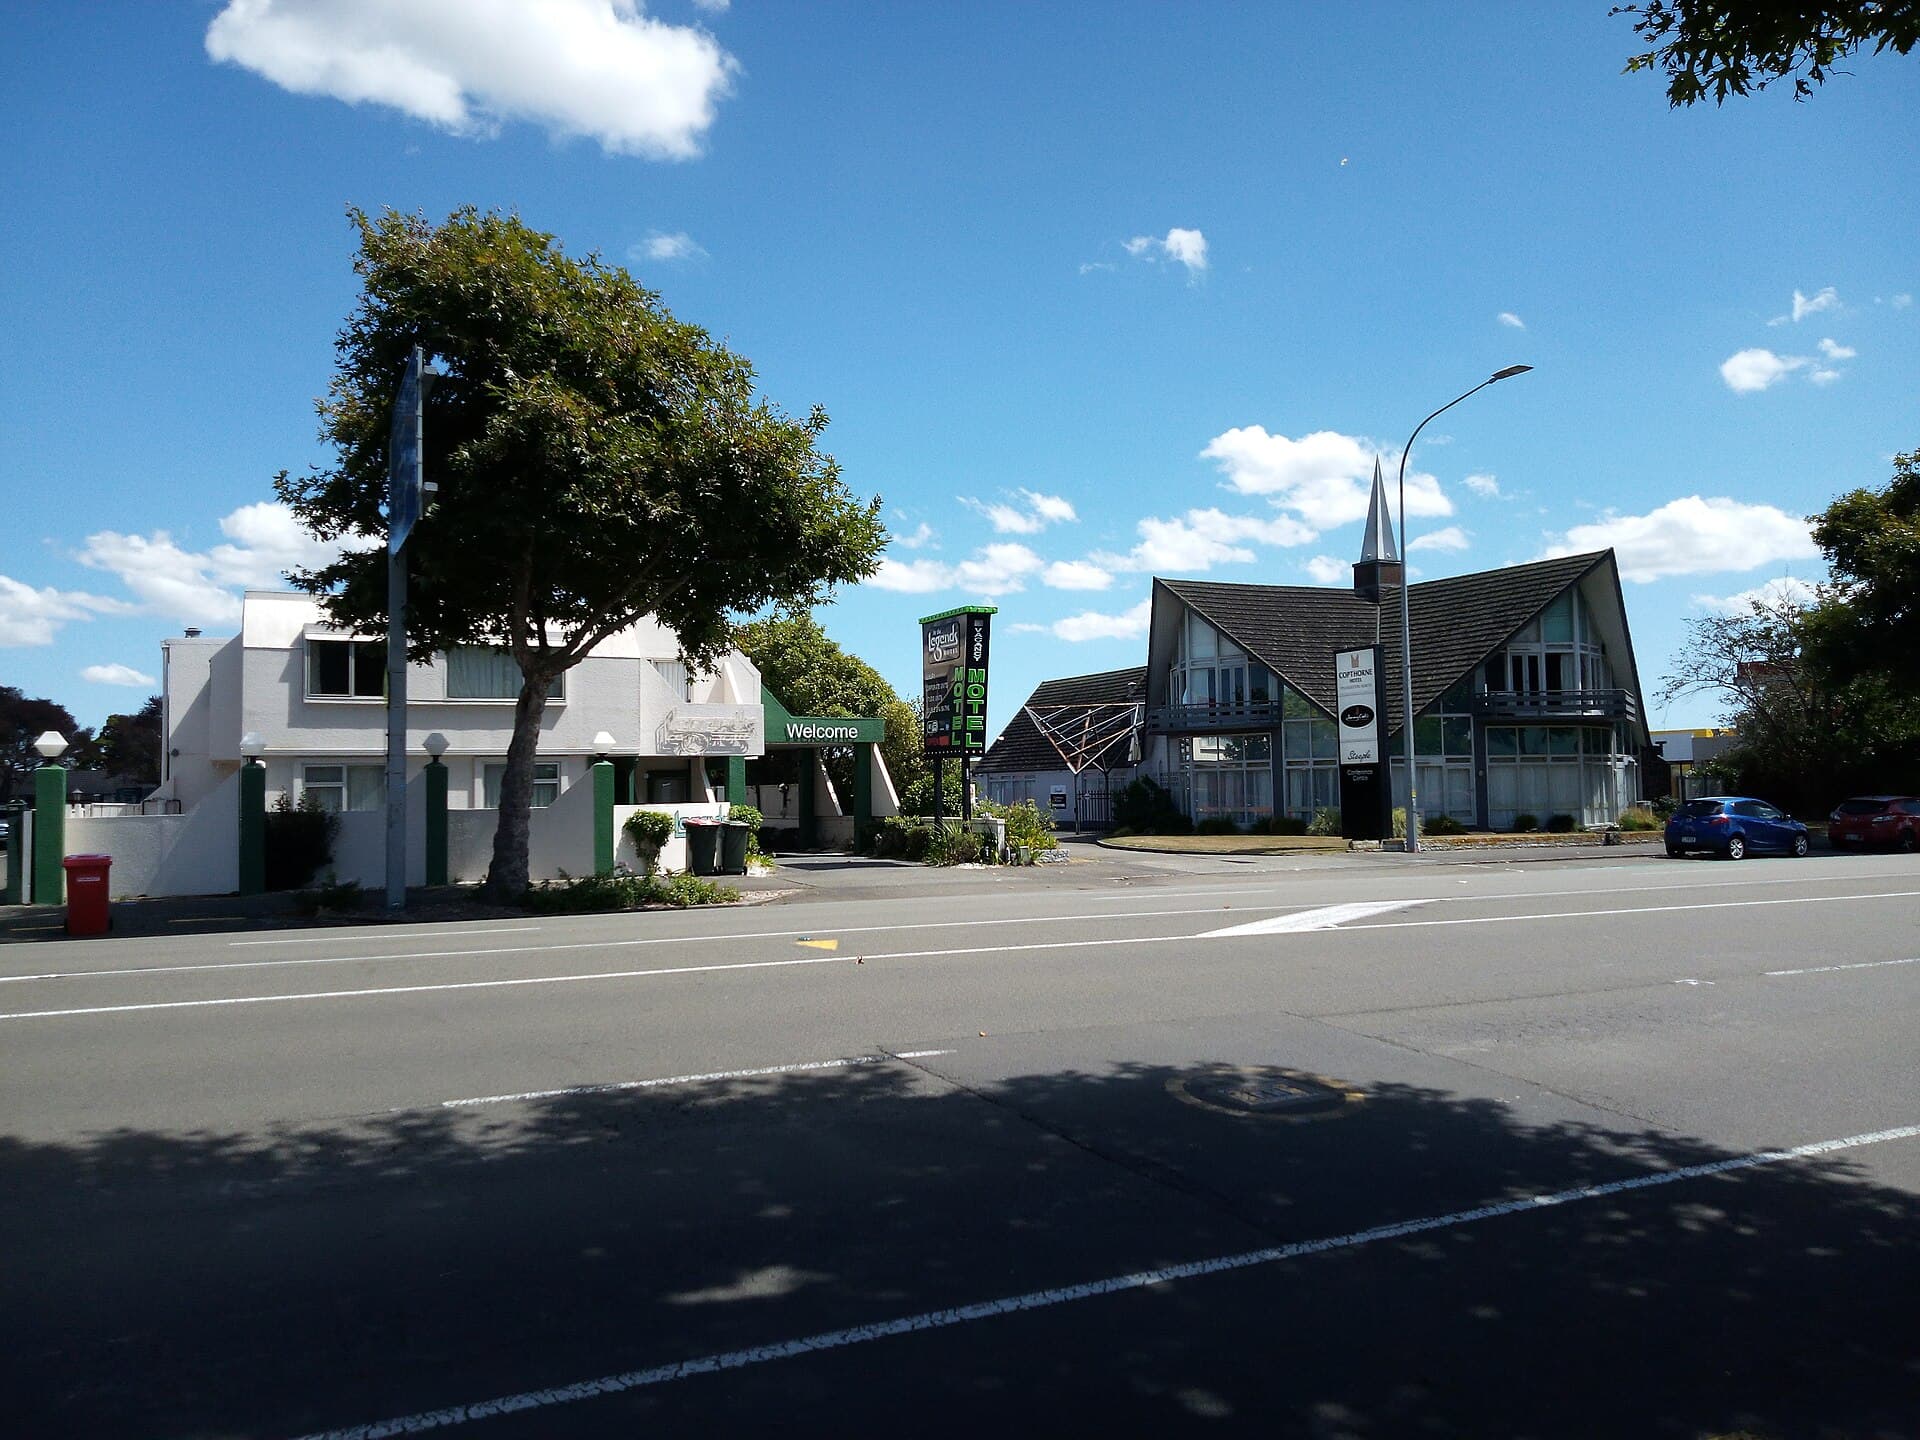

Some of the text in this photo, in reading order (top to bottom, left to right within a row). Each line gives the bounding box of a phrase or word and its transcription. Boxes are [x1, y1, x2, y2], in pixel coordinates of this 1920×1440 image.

[974, 628, 983, 662] VACANCY
[1339, 669, 1373, 679] COPTHORNE
[952, 666, 964, 746] MOTEL
[966, 668, 985, 748] MOTEL
[786, 723, 859, 739] Welcome
